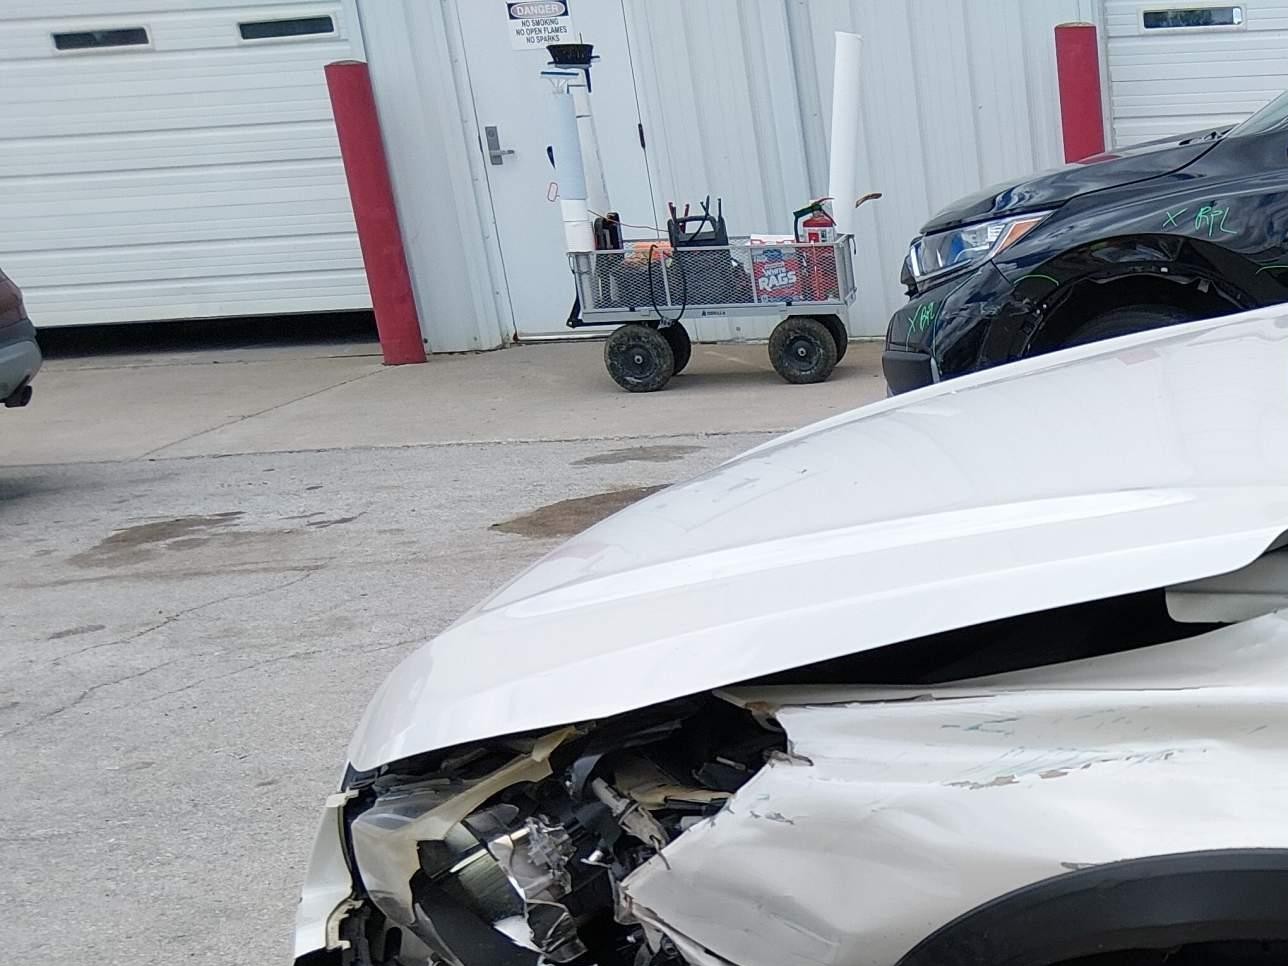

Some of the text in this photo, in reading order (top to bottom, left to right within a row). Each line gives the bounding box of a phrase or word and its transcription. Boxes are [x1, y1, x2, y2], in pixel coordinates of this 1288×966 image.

[516, 4, 559, 16] DANGER
[532, 18, 559, 27] SMOKING
[526, 27, 542, 36] OPEN
[543, 26, 567, 34] FLAMES
[536, 35, 560, 43] SPARKS
[759, 271, 797, 291] RAGS
